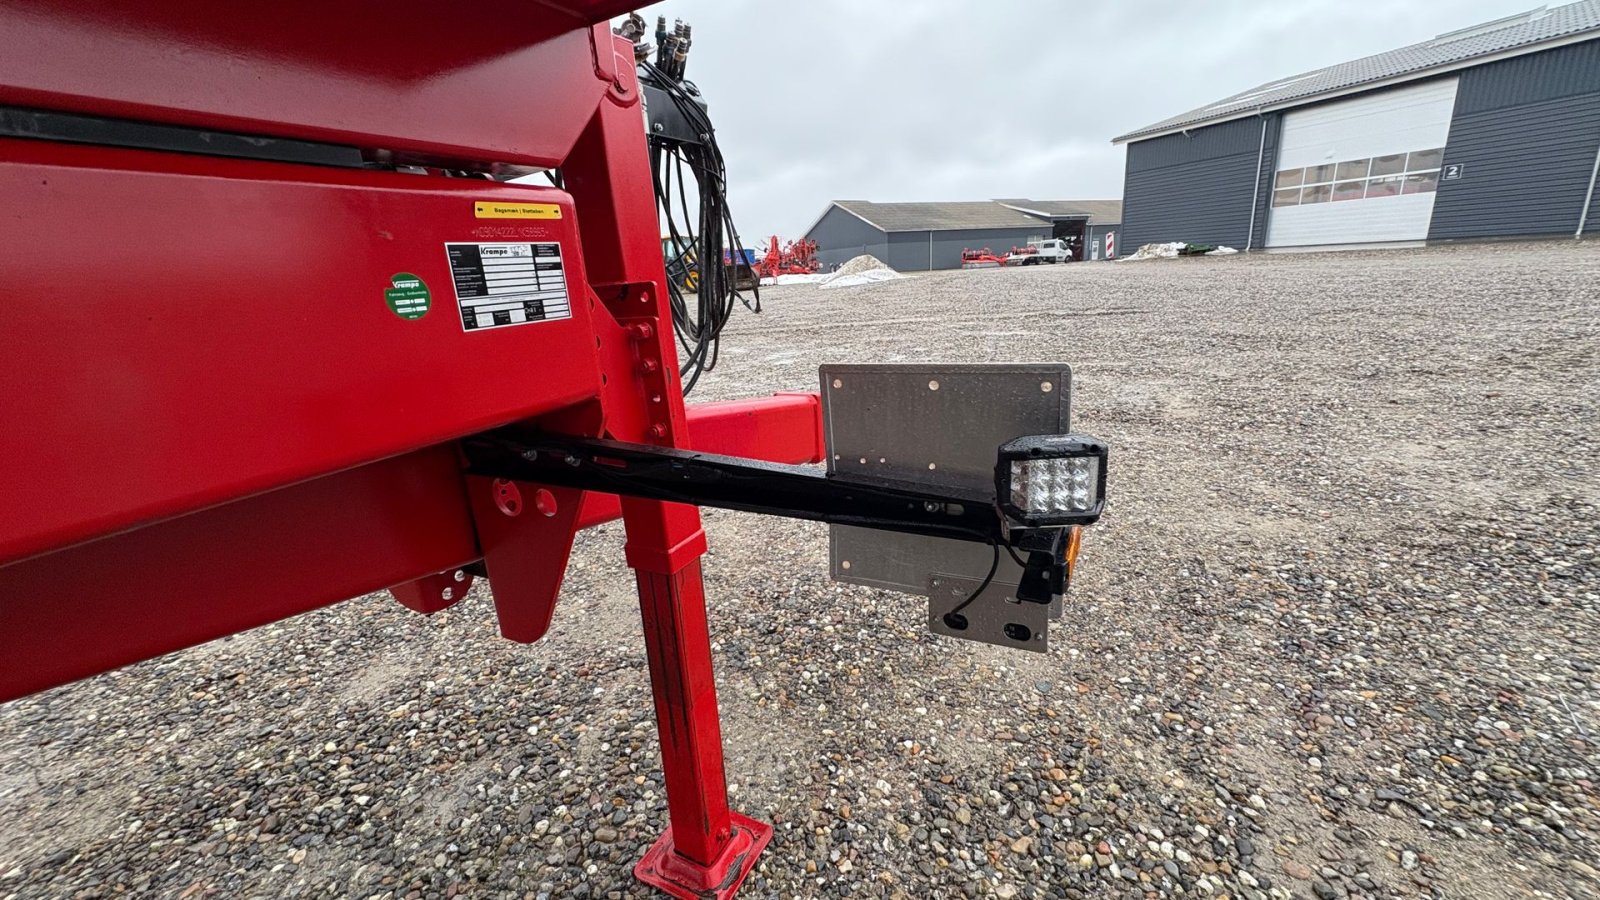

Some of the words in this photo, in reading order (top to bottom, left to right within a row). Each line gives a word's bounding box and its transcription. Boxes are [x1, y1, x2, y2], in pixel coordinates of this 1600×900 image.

[1448, 166, 1458, 176] 2
[480, 246, 508, 256] Krampe
[392, 280, 420, 289] Krampe
